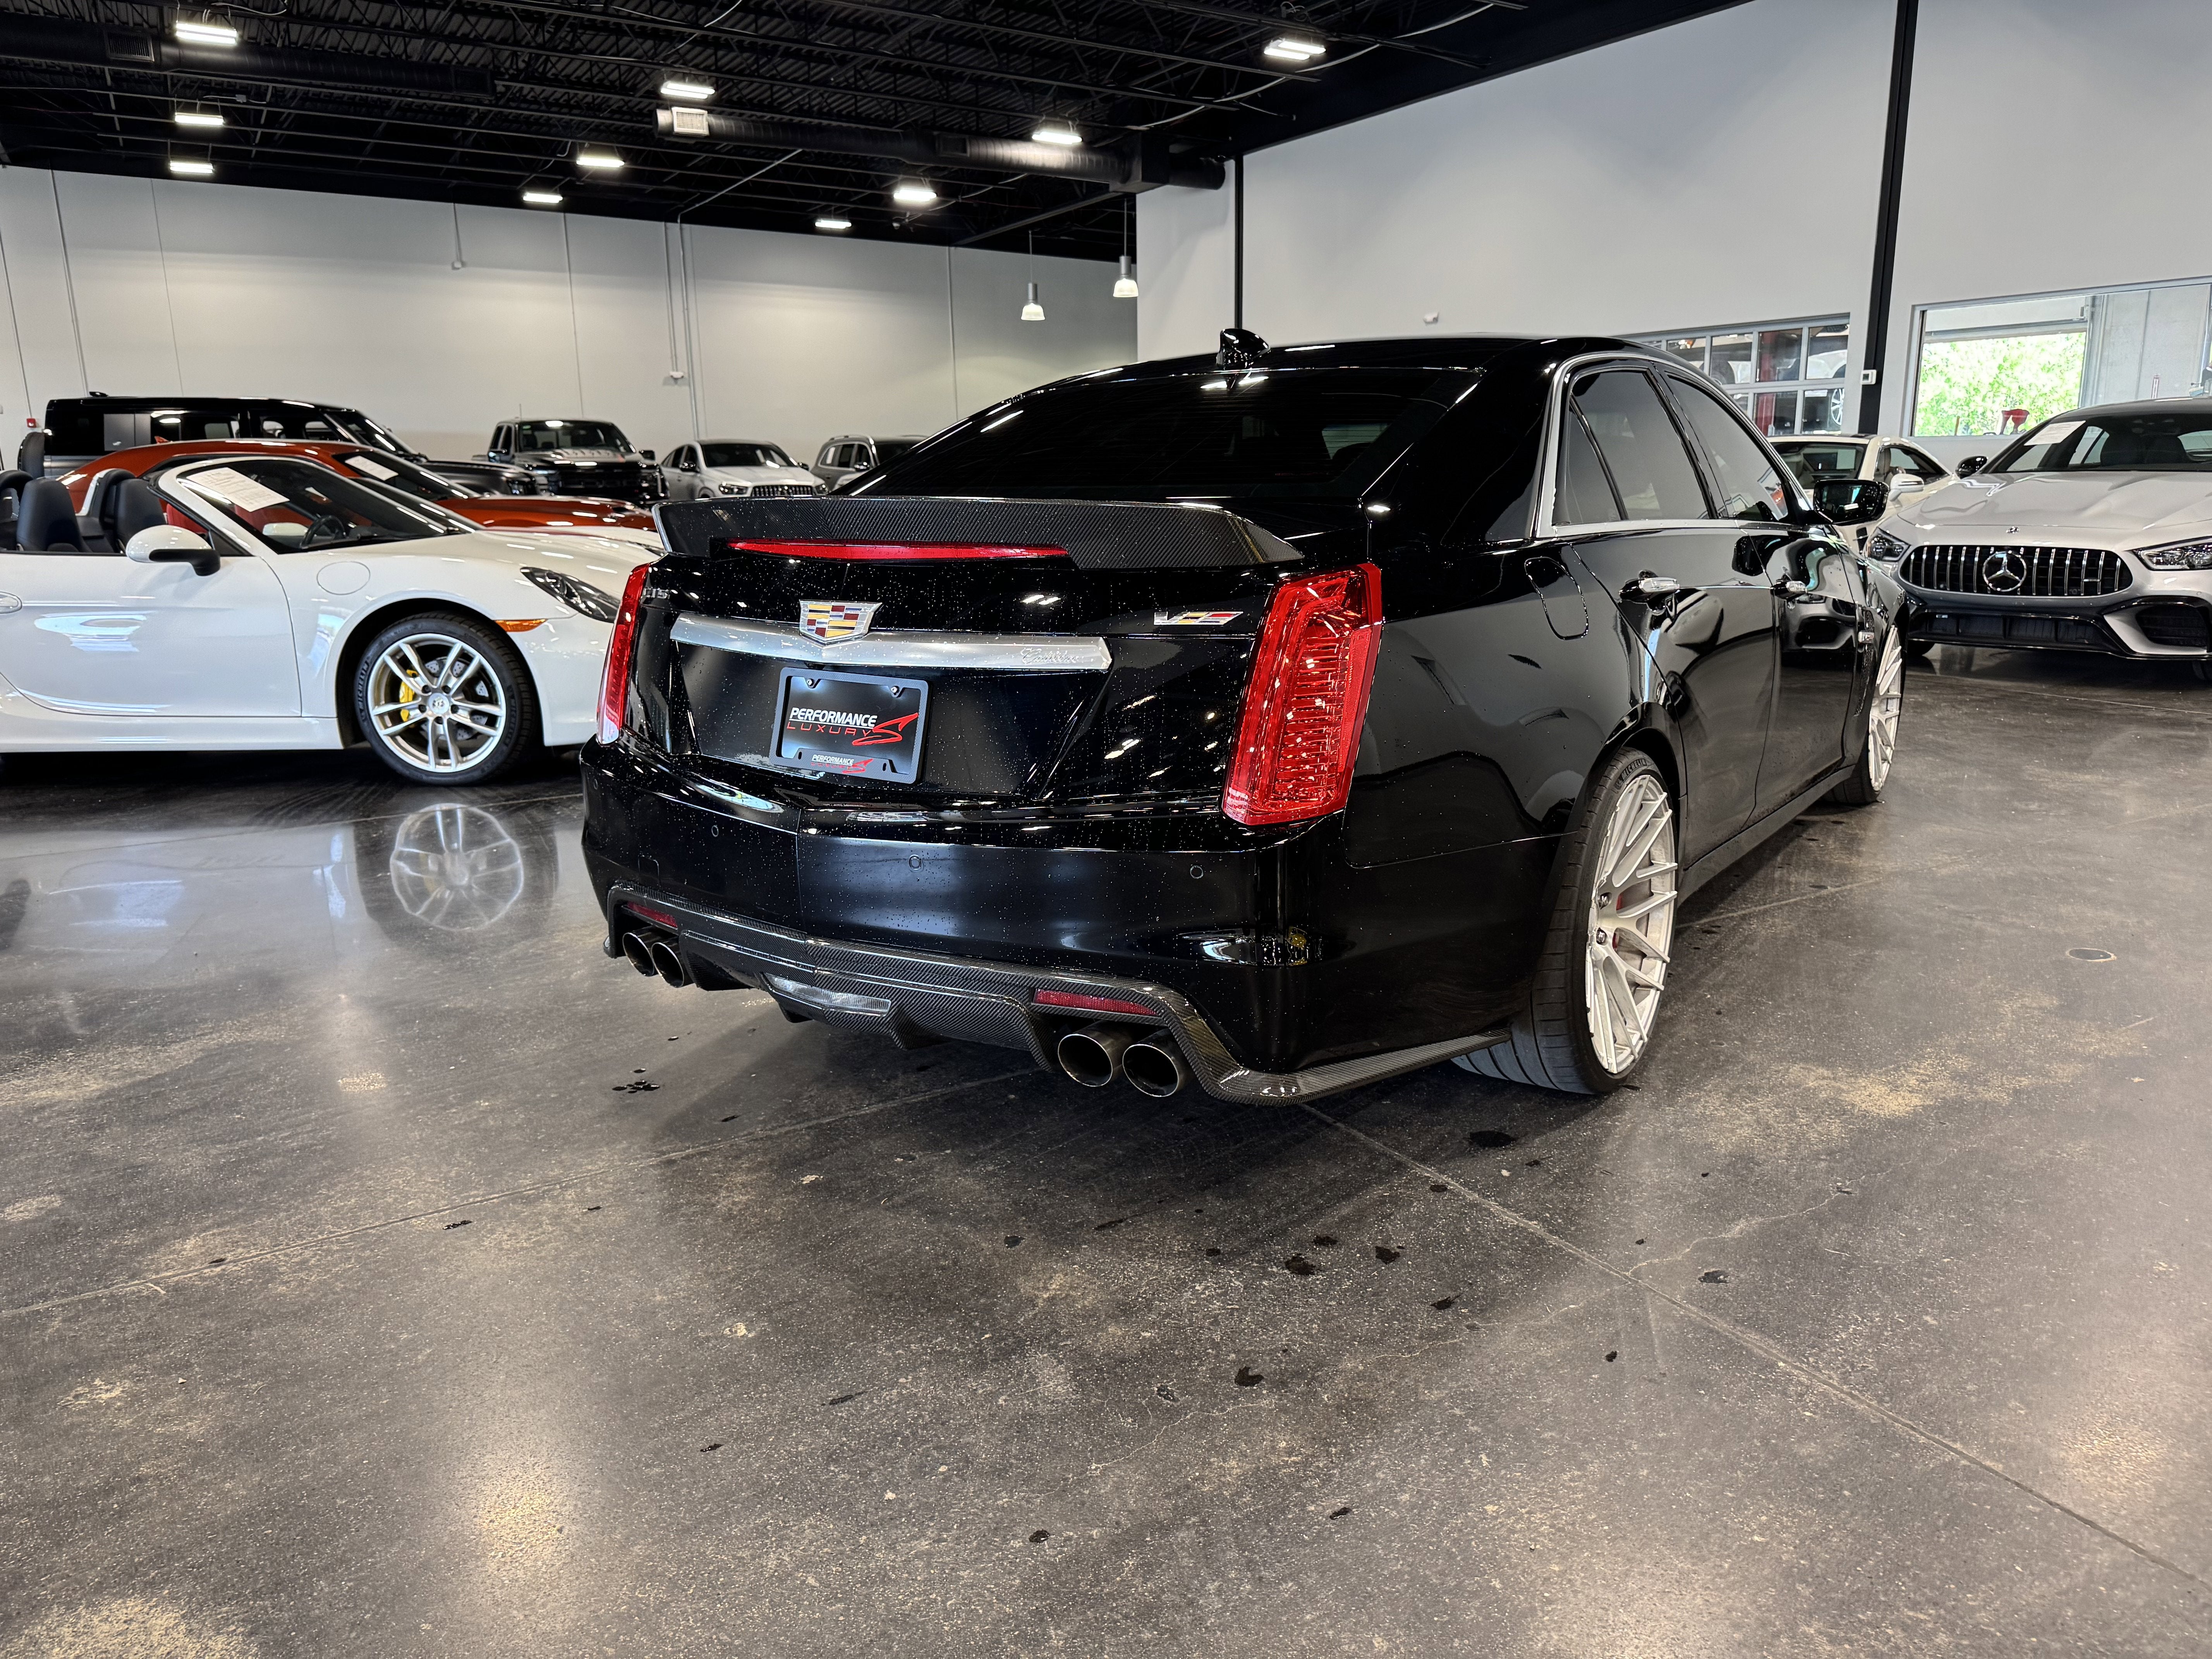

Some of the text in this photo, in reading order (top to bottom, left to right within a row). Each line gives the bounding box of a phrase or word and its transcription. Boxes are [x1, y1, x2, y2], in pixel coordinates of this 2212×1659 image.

[1020, 647, 1080, 665] Cadillac
[789, 707, 878, 727] PERFORMANCE
[787, 722, 873, 736] LUXURY
[812, 754, 854, 766] PERFORMANCE
[1621, 758, 1648, 781] MICHELIN
